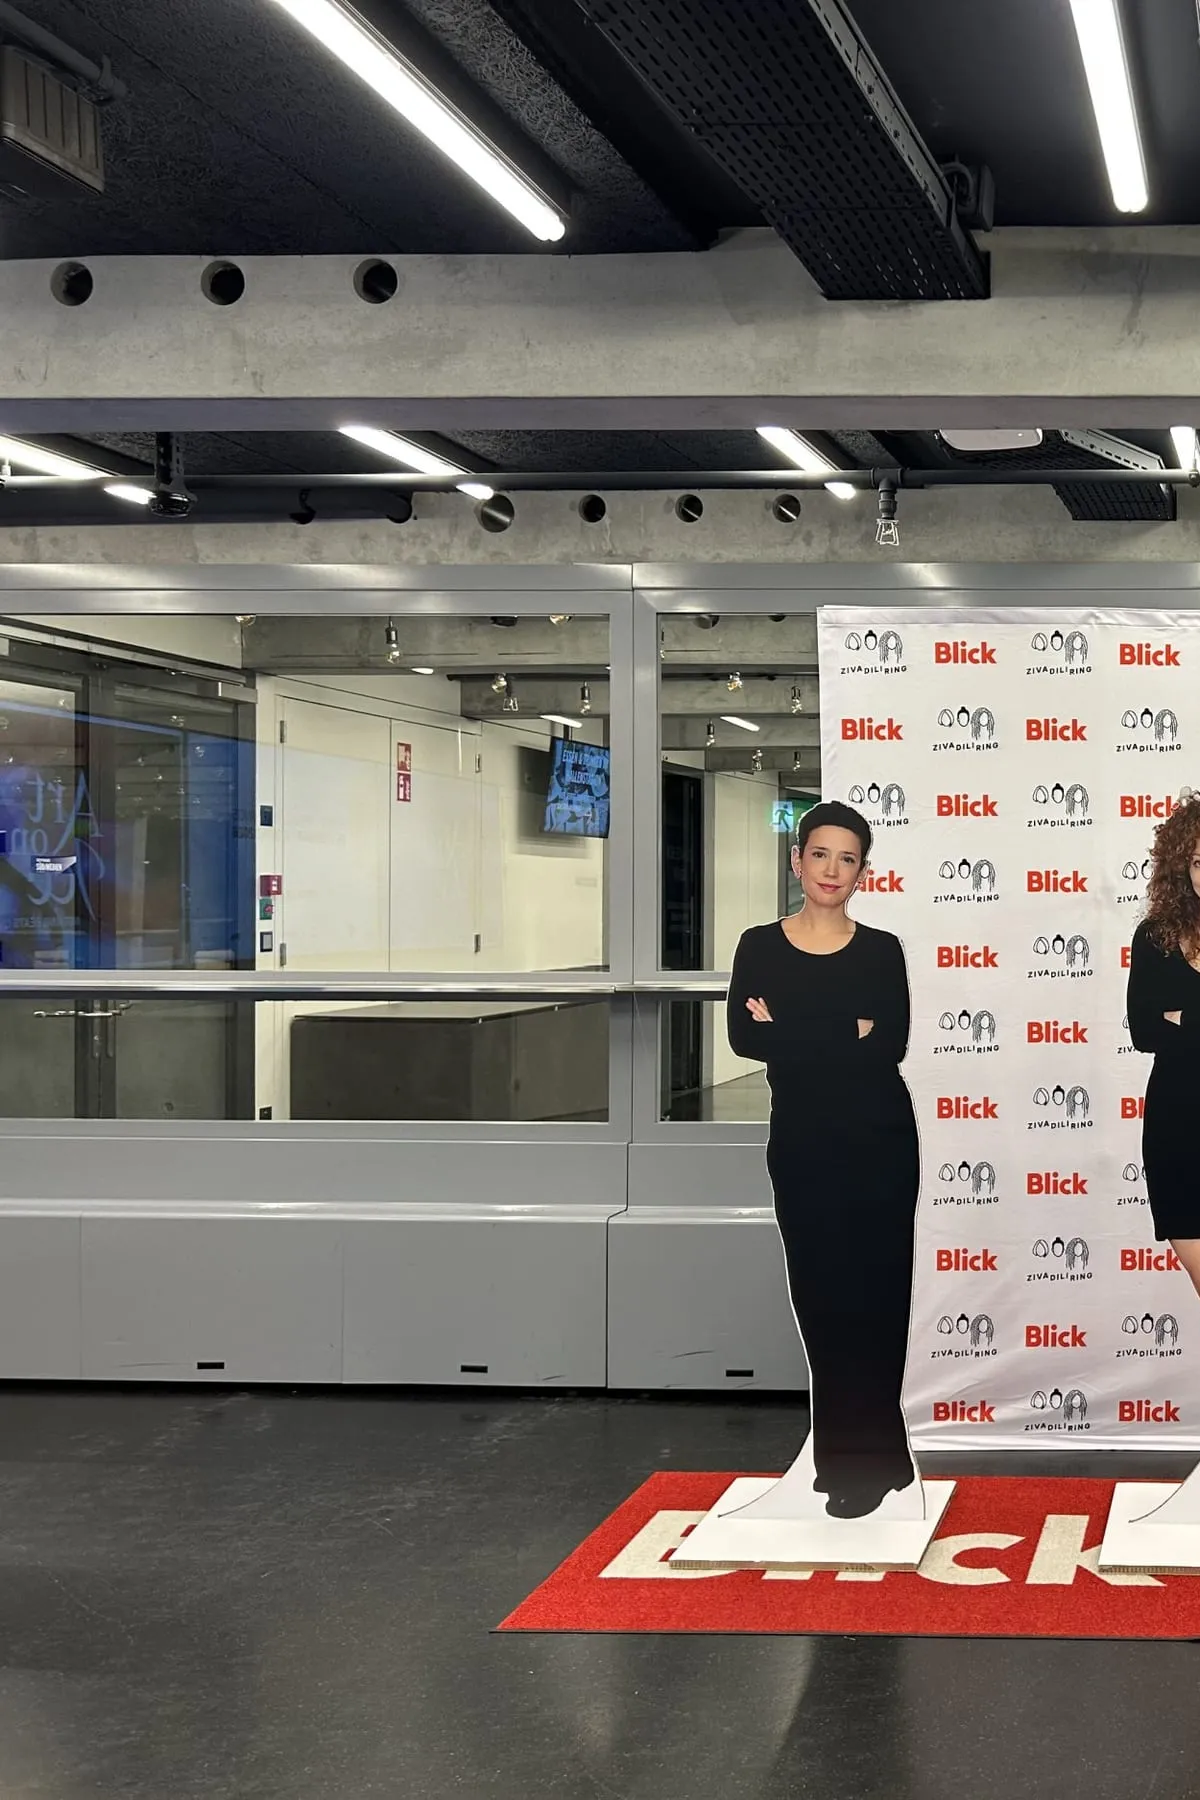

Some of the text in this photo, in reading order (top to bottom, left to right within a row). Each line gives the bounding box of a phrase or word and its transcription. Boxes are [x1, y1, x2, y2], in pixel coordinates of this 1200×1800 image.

[936, 643, 994, 663] Blick
[1120, 644, 1178, 665] Blick
[842, 719, 901, 740] Blick
[1027, 720, 1085, 741] Blick
[938, 796, 996, 816] Blick
[858, 870, 904, 892] ick
[1028, 871, 1086, 892] Blick
[938, 947, 997, 967] Blick
[1028, 1022, 1087, 1043] Blick
[938, 1097, 996, 1118] Blick
[1028, 1173, 1086, 1194] Blick
[937, 1249, 996, 1271] Blick
[1121, 1248, 1182, 1271] Blick
[1026, 1326, 1085, 1347] Blick
[934, 1401, 993, 1421] Blick
[1118, 1401, 1177, 1422] Blick
